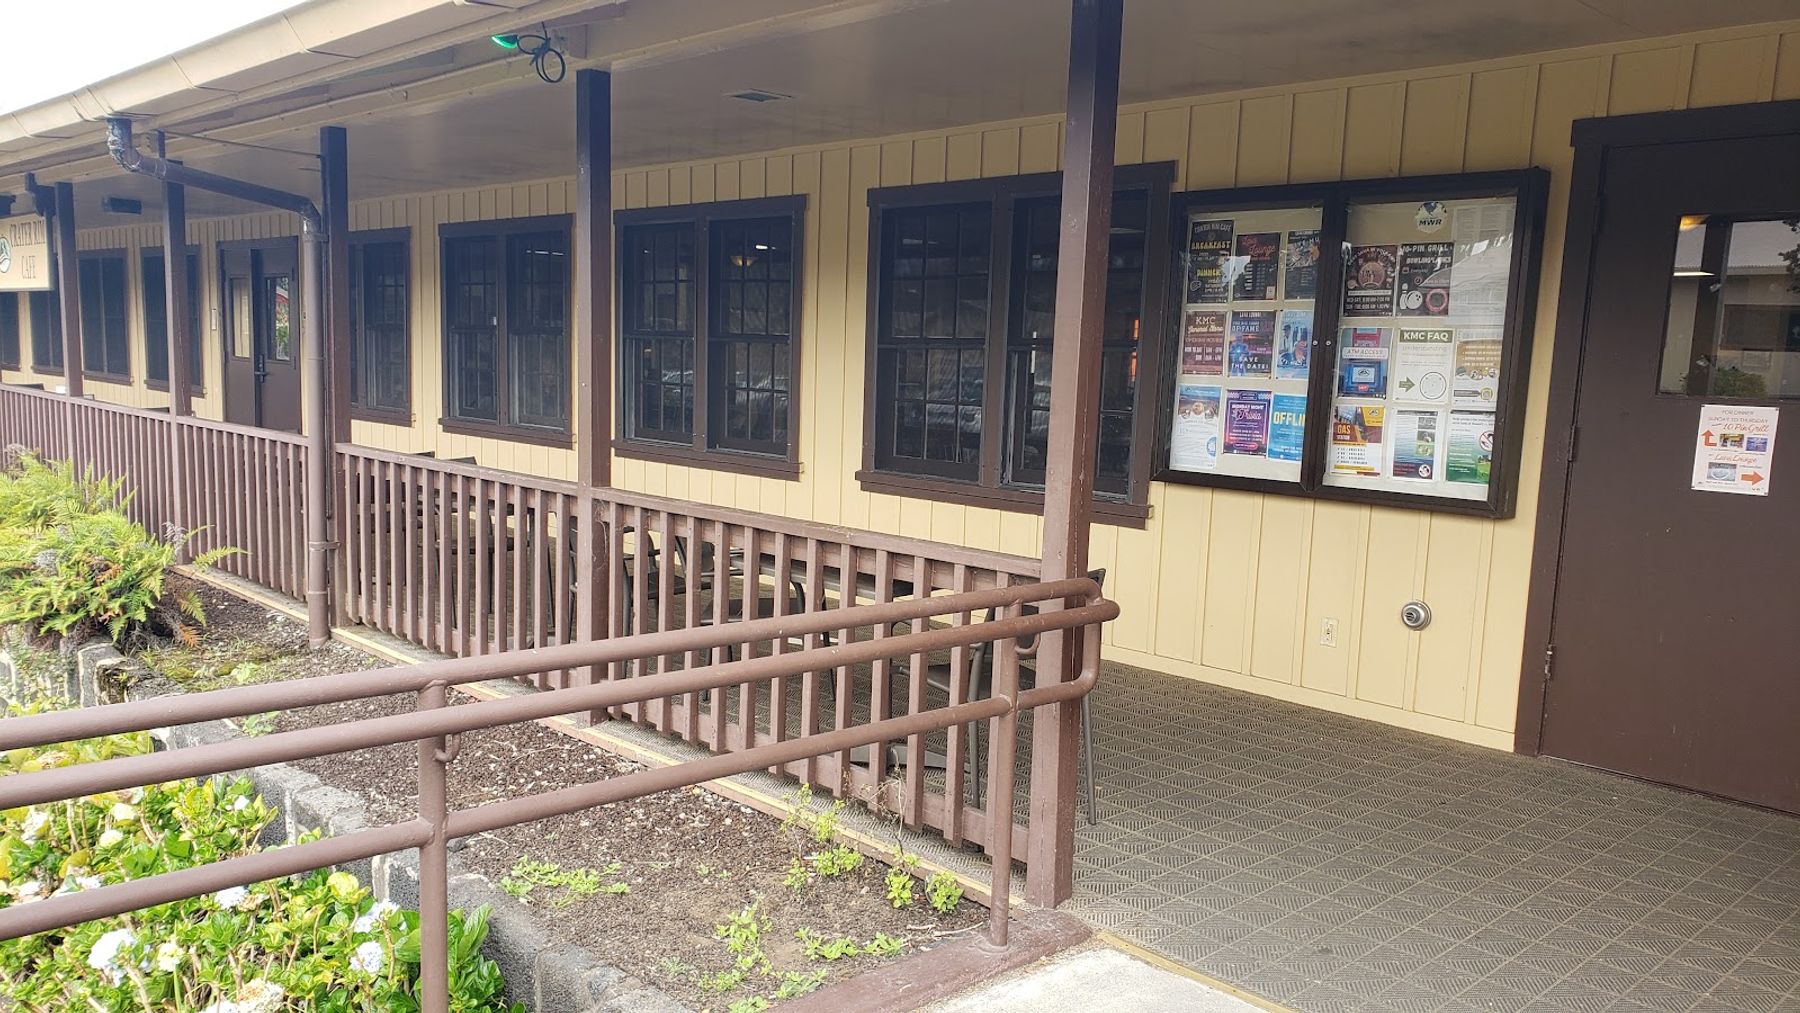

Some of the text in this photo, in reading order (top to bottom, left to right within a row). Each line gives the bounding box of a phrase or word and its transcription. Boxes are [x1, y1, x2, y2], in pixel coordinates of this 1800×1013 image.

[1418, 218, 1442, 226] MWR
[1191, 240, 1231, 250] BREAKFAST
[1427, 244, 1449, 252] GRILL
[1248, 245, 1277, 257] Lounge
[1195, 316, 1216, 325] KMC
[1403, 331, 1425, 340] KMC
[1427, 331, 1449, 341] FAQ
[1337, 424, 1351, 435] GAS
[1747, 423, 1769, 433] Grill
